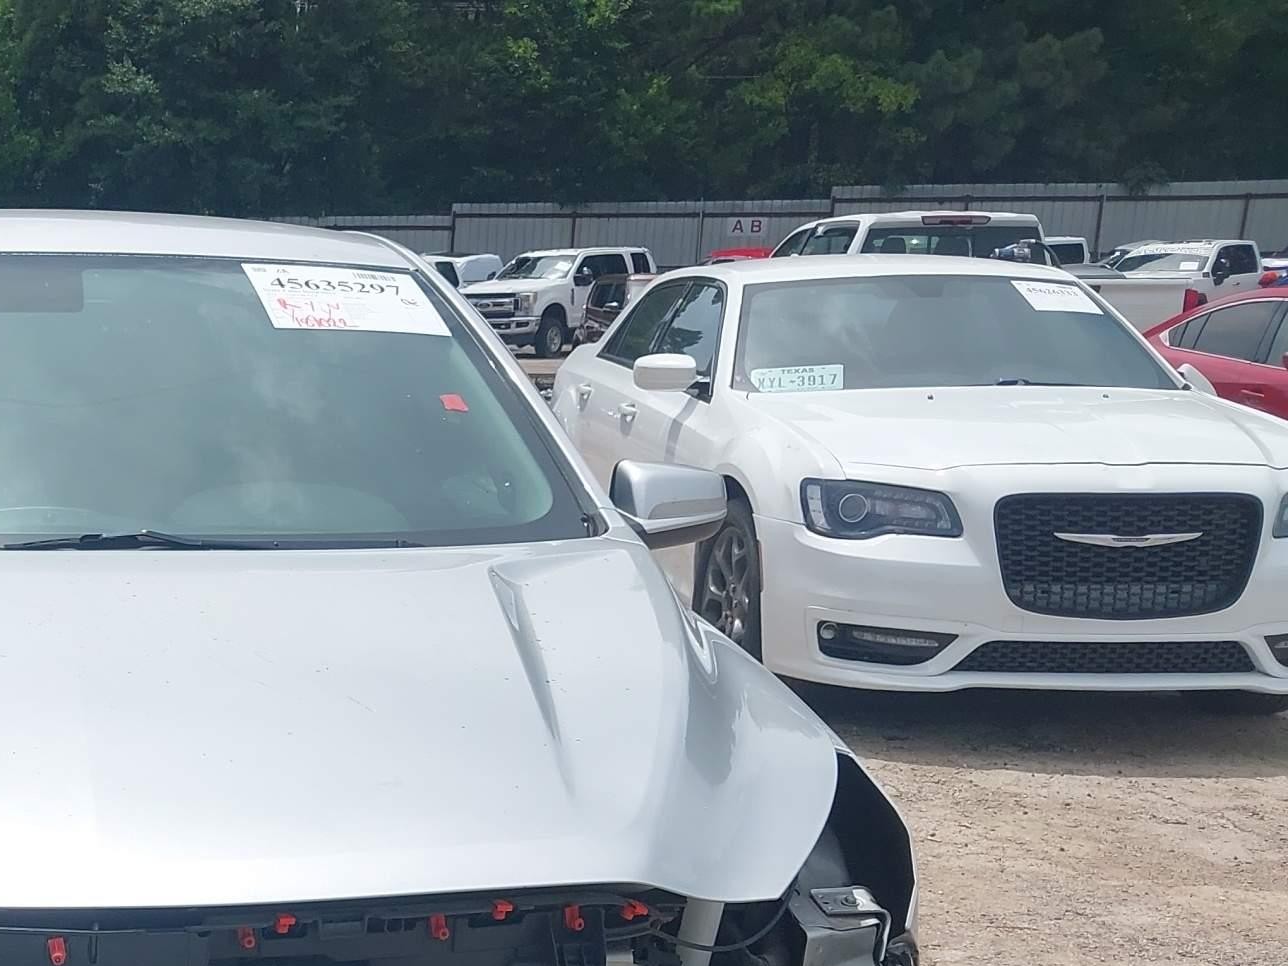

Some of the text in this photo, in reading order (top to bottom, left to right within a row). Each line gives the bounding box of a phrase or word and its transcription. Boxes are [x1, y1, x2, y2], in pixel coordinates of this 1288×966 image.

[731, 218, 762, 233] A B
[270, 277, 400, 296] 45635297
[781, 367, 815, 375] TEXAS
